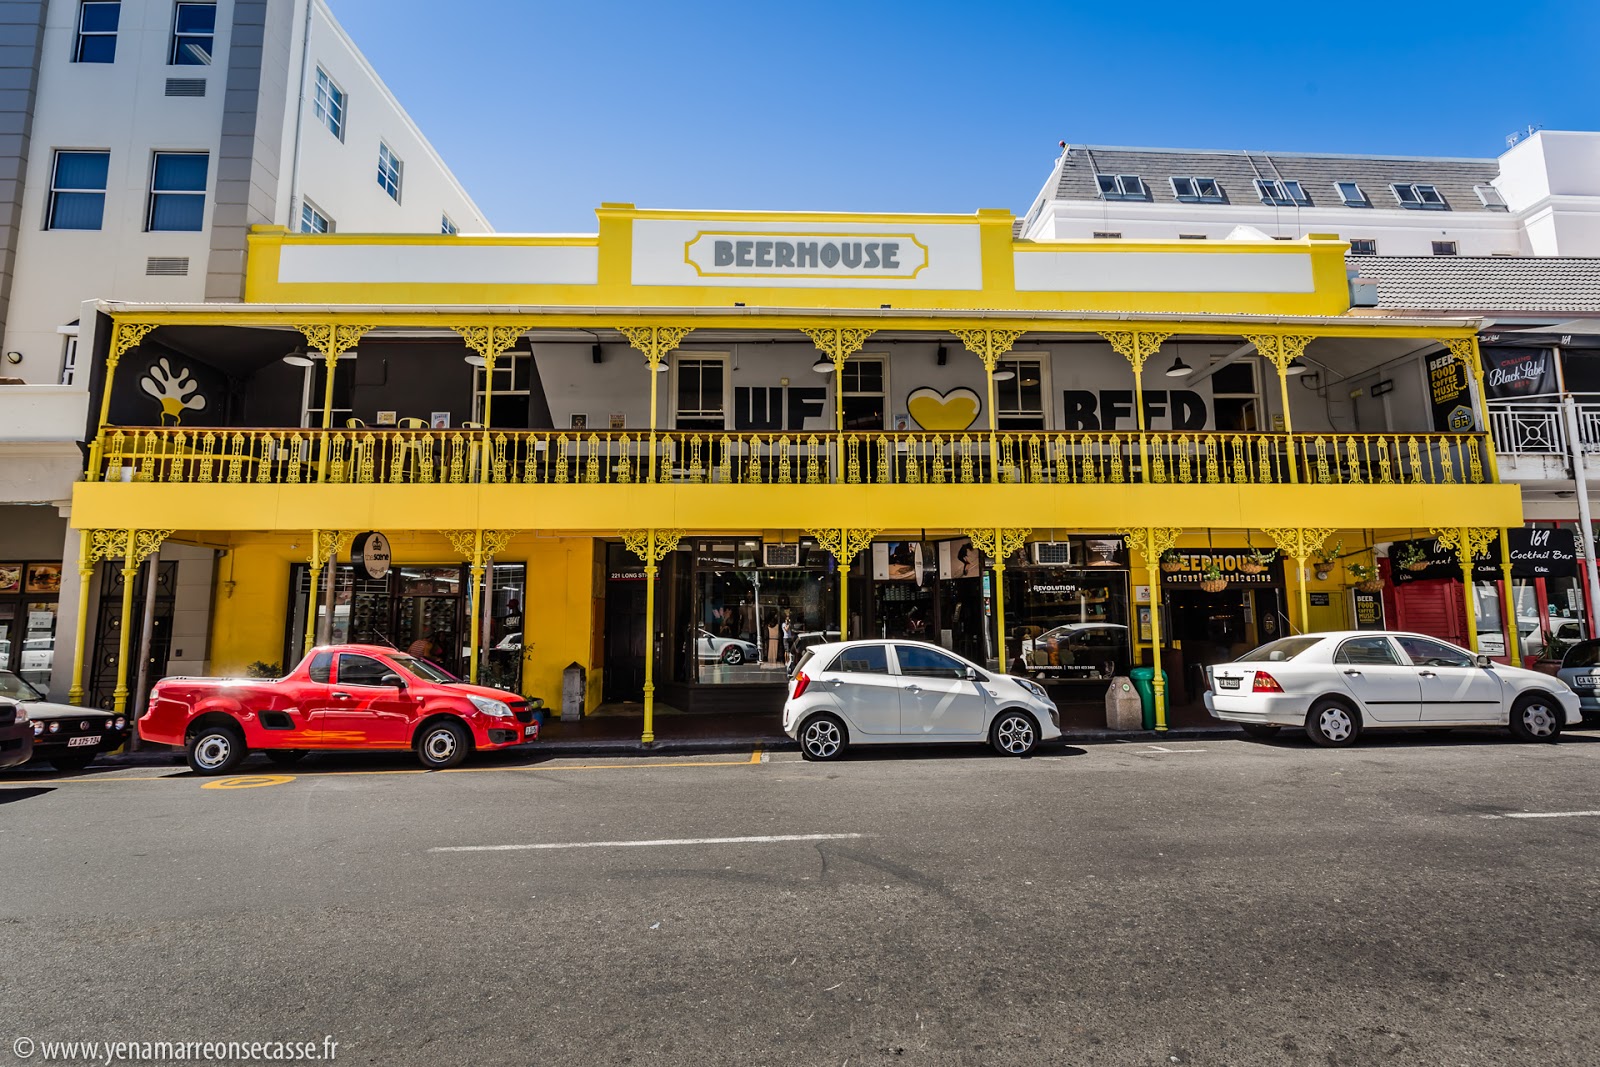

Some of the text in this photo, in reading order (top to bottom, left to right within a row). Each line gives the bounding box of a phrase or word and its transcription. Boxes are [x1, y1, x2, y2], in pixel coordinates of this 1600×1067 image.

[714, 240, 900, 269] BEERHOUSE
[1561, 335, 1571, 345] 169
[1430, 354, 1455, 371] BEER
[1501, 355, 1531, 367] CARLING
[1431, 364, 1456, 381] FOOD
[1489, 366, 1520, 387] Black
[1520, 359, 1546, 380] Label
[1432, 374, 1458, 389] COFFEE
[1433, 382, 1458, 397] MUSIC
[1530, 530, 1550, 546] 169
[1510, 550, 1573, 560] Cocktail Bar
[69, 738, 77, 746] CA
